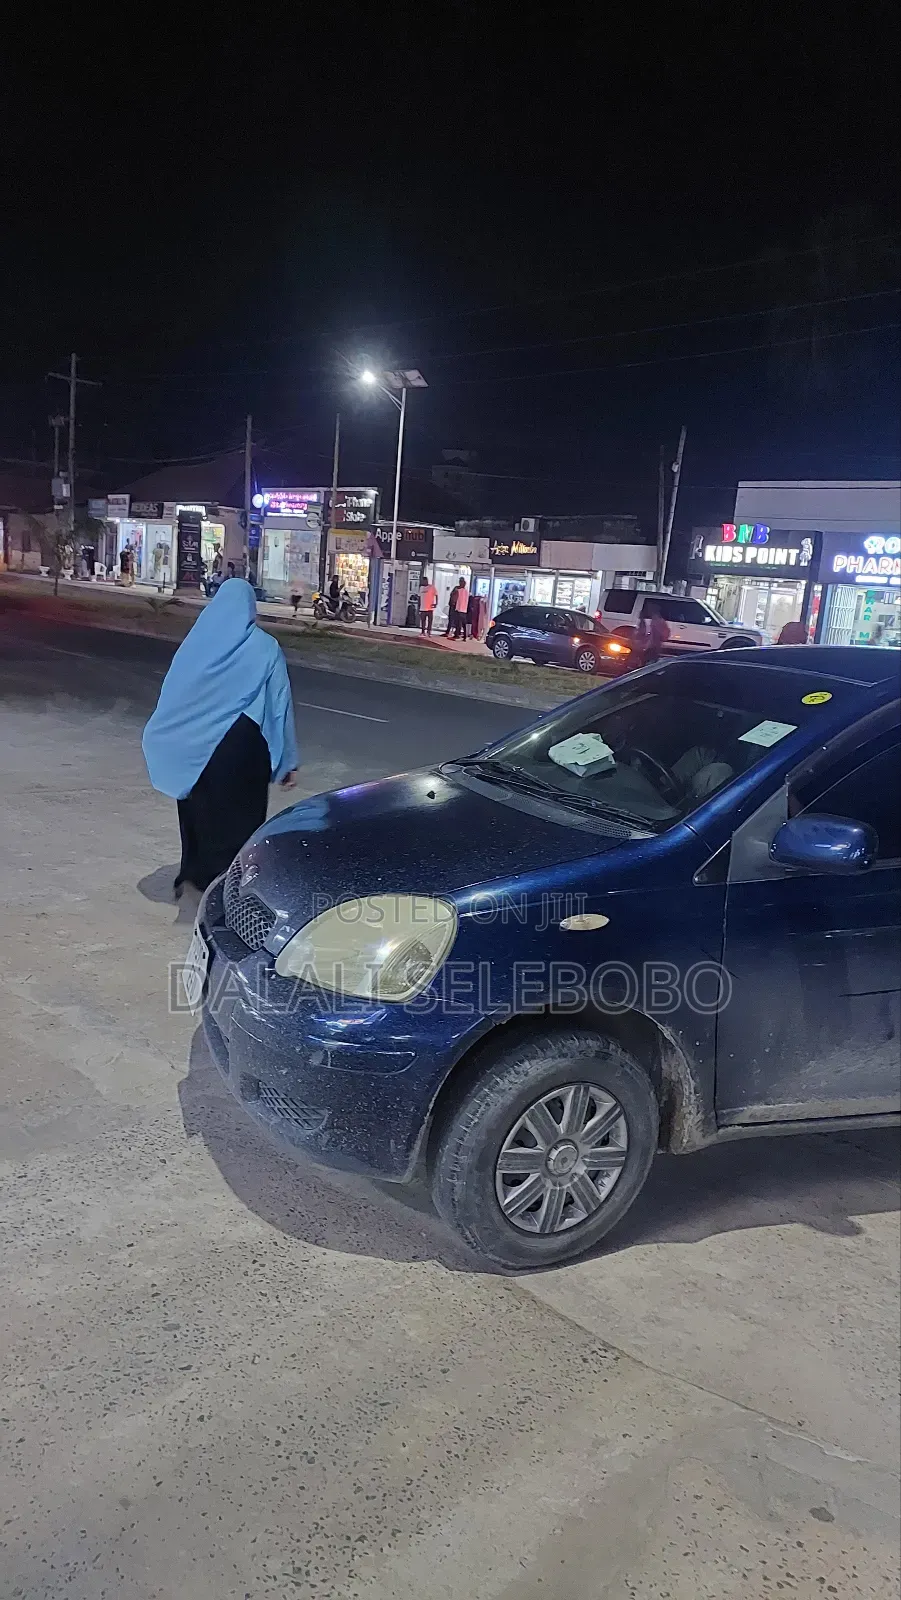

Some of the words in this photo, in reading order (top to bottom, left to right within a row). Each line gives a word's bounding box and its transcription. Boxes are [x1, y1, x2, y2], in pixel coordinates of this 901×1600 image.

[375, 528, 403, 543] Appe
[721, 523, 770, 544] BNB
[704, 544, 744, 564] KIDS
[745, 546, 800, 566] POINT
